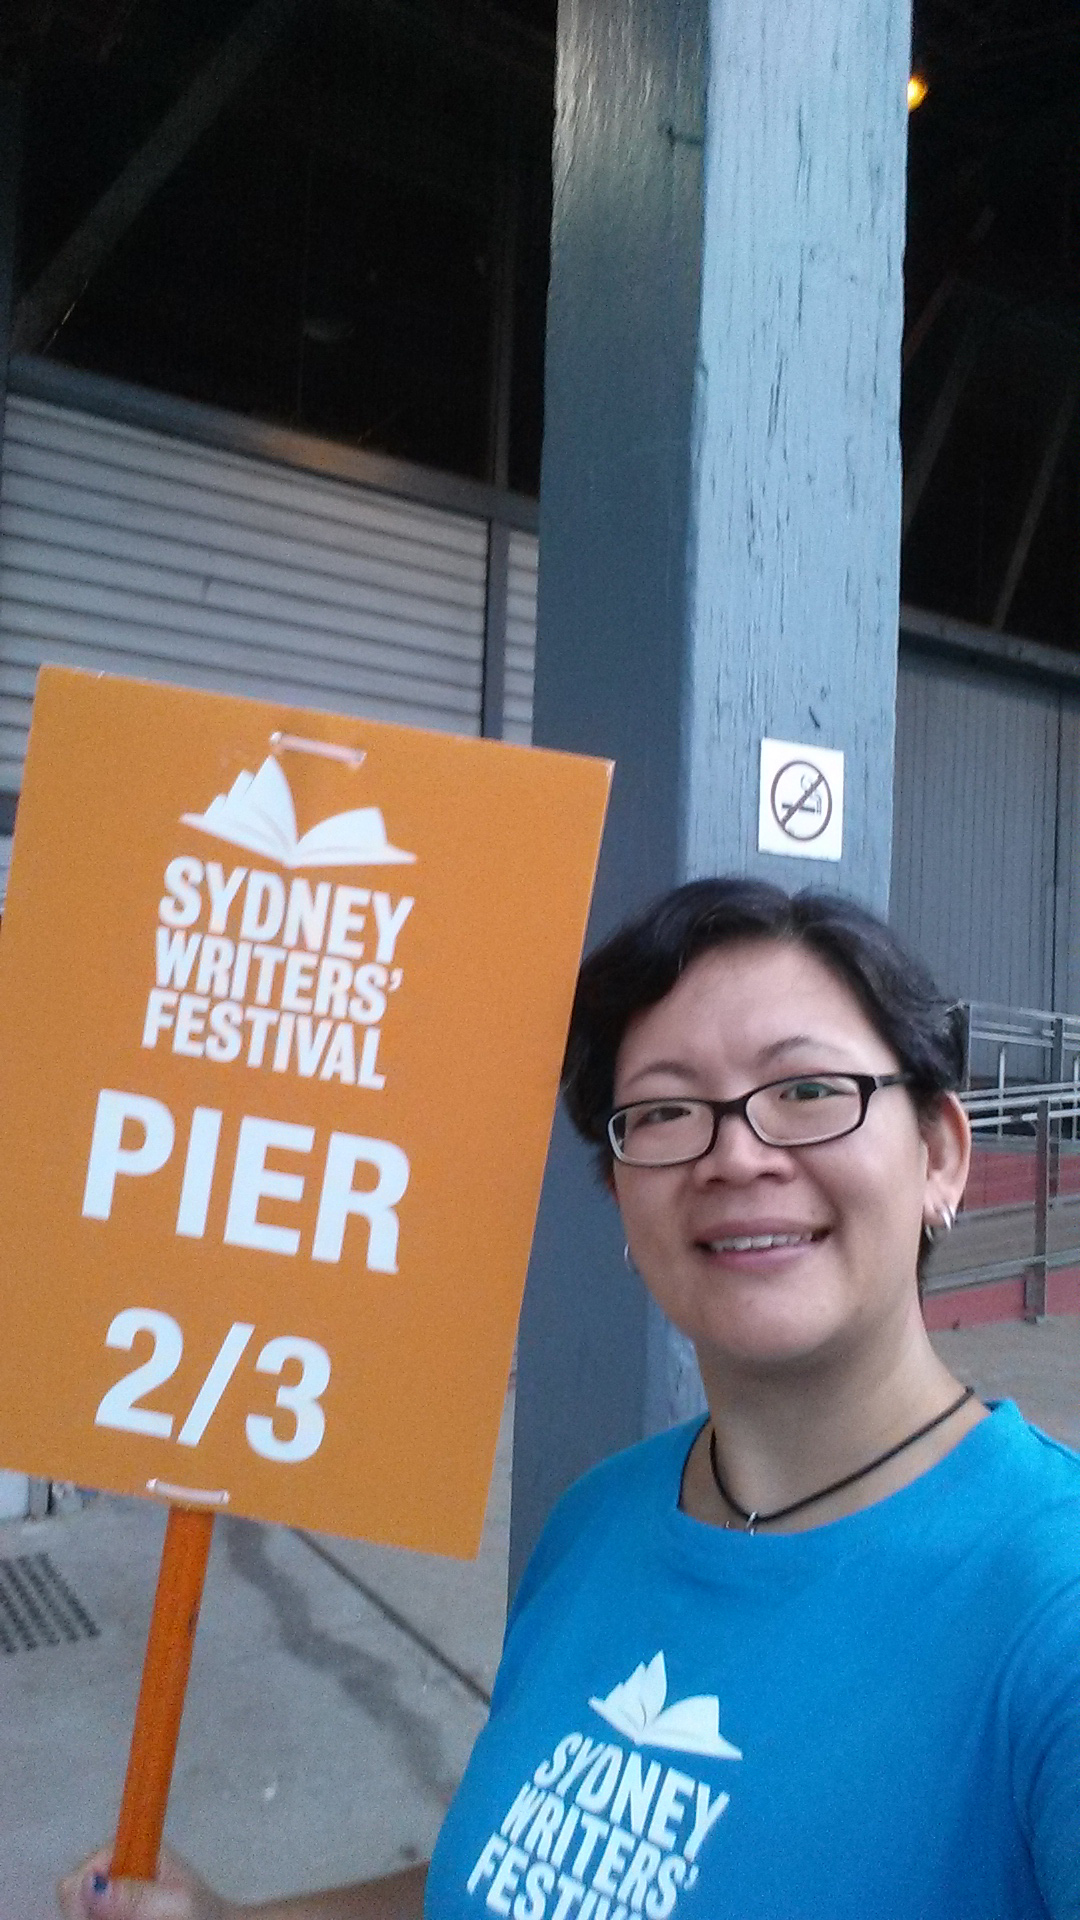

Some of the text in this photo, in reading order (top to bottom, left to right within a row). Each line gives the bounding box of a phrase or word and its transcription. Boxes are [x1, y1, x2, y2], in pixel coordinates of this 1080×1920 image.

[158, 855, 415, 965] SYDNEY
[142, 988, 387, 1091] FESTIVAL
[81, 1089, 411, 1275] PIER
[95, 1307, 332, 1464] 2/3
[534, 1732, 730, 1863] SYDNEY
